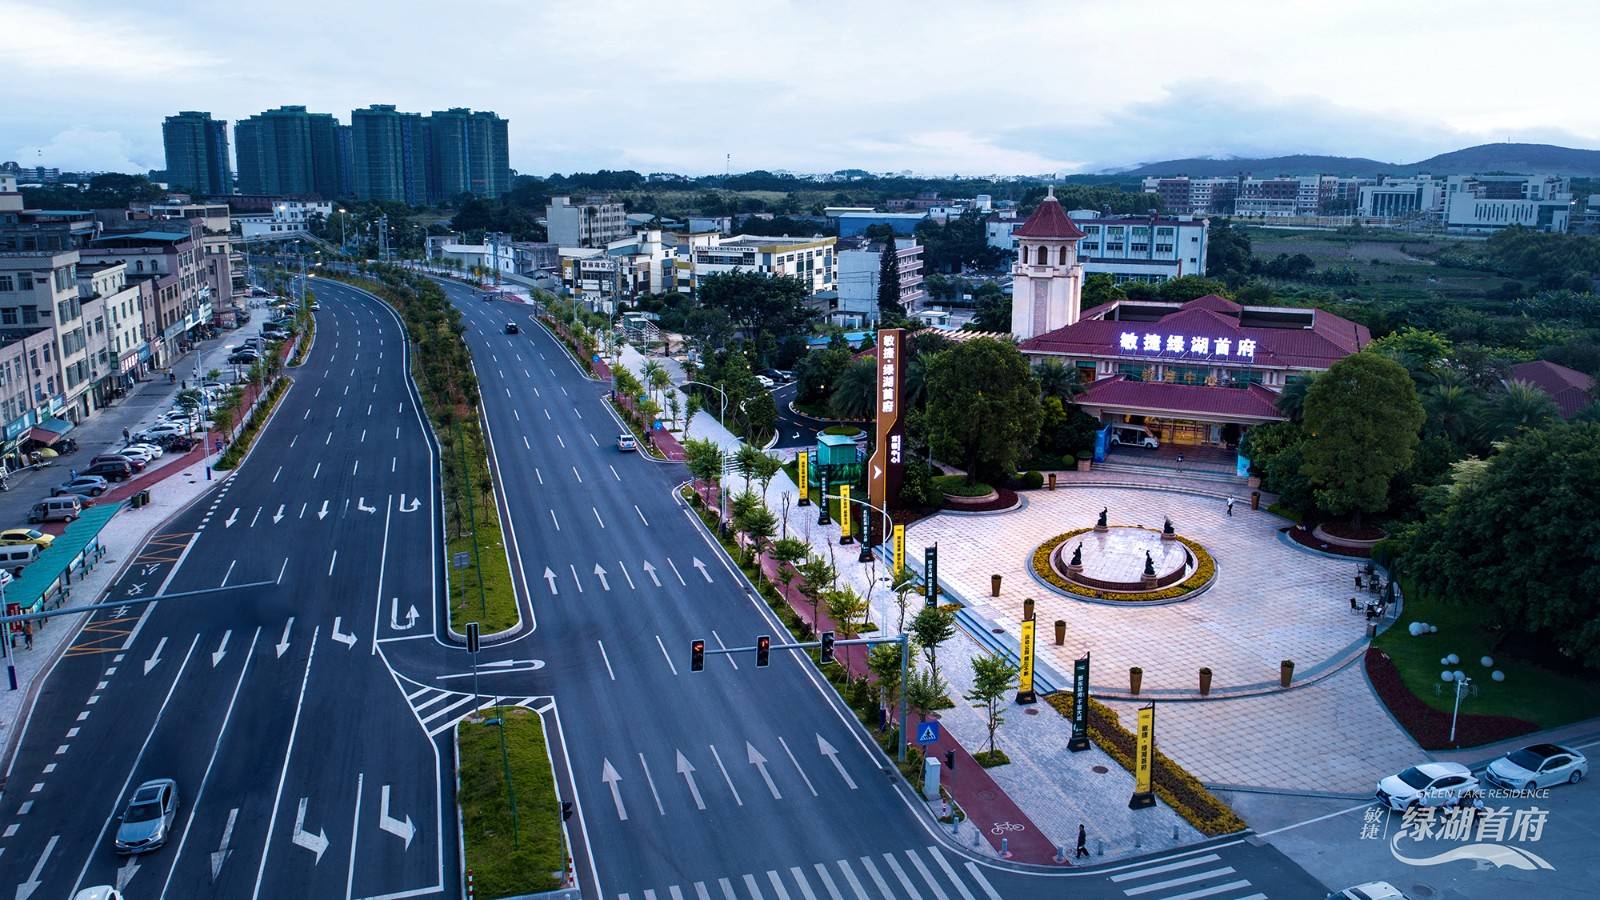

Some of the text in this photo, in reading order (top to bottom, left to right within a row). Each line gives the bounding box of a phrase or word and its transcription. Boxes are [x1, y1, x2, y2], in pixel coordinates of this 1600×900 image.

[1119, 332, 1257, 357] 敏捷绿湖首府
